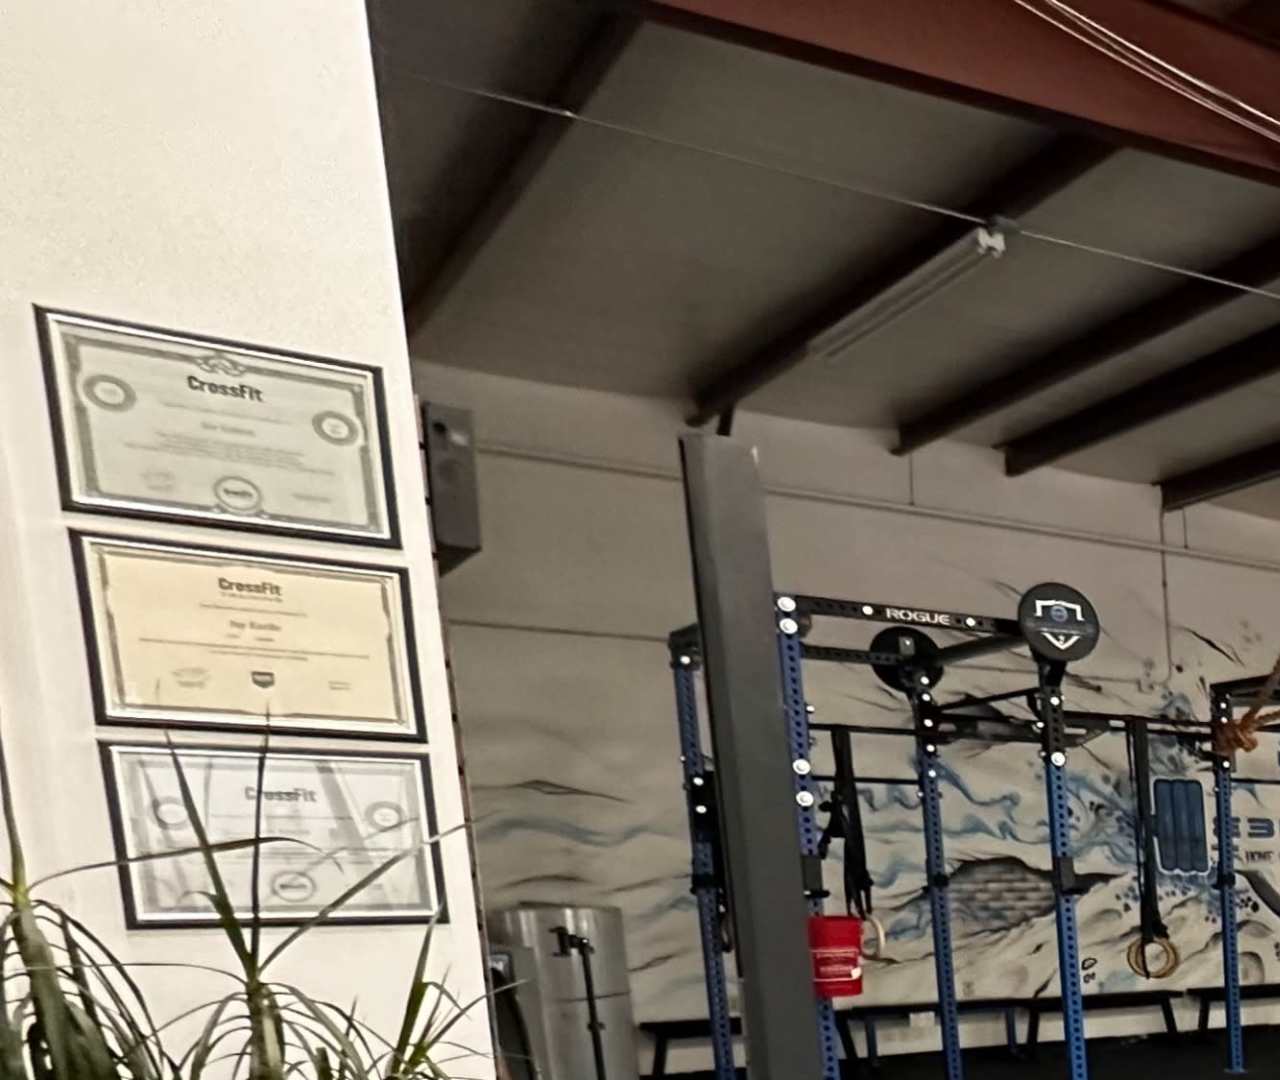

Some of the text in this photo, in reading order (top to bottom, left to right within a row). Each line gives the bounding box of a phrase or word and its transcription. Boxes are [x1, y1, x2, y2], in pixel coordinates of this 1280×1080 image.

[187, 375, 264, 403] CrossFit
[218, 577, 283, 597] CrossFit
[886, 607, 950, 626] ROGUE
[245, 786, 318, 803] CossFit
